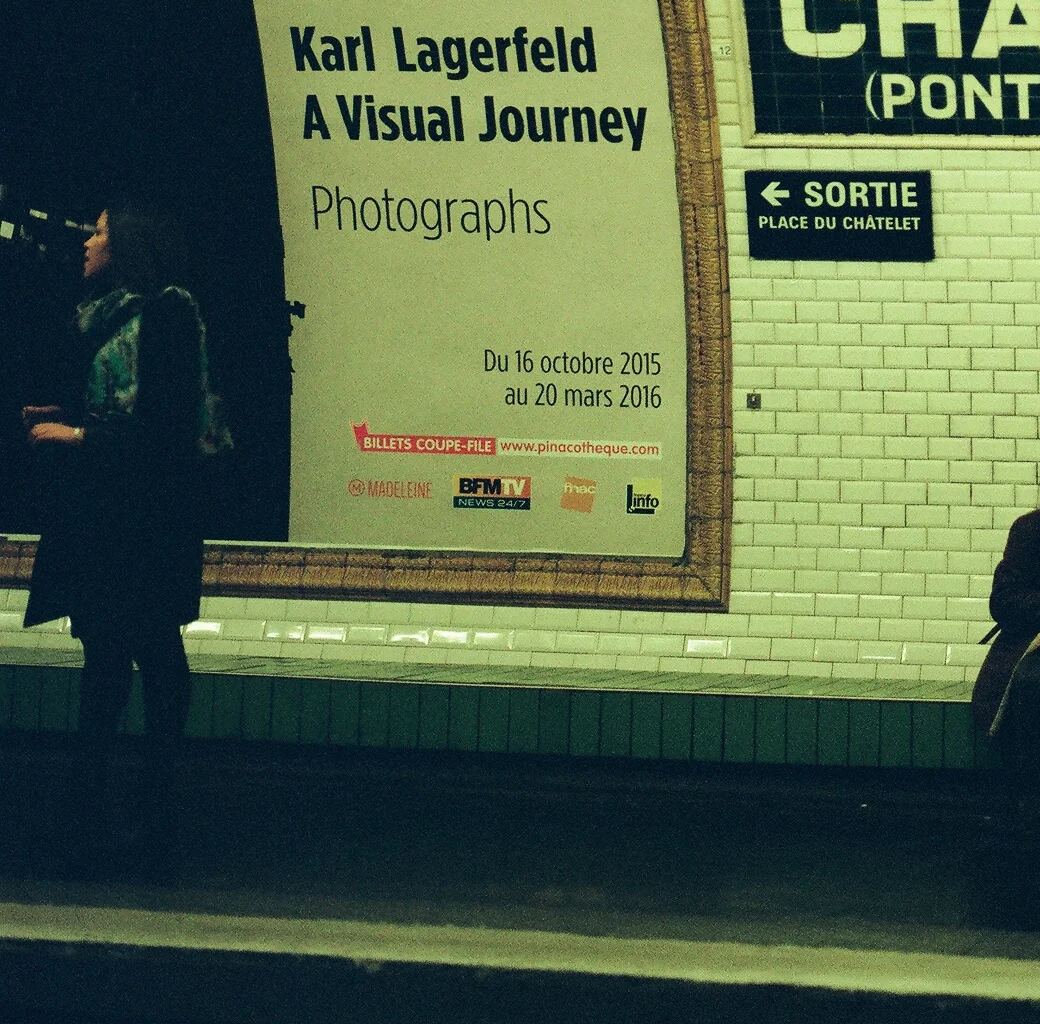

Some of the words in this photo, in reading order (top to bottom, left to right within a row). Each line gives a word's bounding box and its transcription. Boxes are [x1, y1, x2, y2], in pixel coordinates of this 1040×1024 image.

[290, 26, 375, 72] Karl
[393, 26, 597, 80] Lagerfeld
[720, 46, 731, 55] 12
[864, 71, 1040, 122] (PONT
[303, 94, 331, 140] A
[336, 94, 465, 142] Visual
[479, 95, 647, 151] Journey
[804, 181, 918, 207] SORTIE
[312, 186, 551, 241] Photographs
[758, 215, 808, 229] PLACE
[814, 216, 837, 229] DU
[843, 215, 920, 230] CHÂTELET
[484, 349, 508, 372] Du
[515, 350, 534, 373] 16
[540, 352, 613, 375] octobre
[620, 352, 661, 375] 2015
[505, 387, 527, 405] au
[535, 383, 557, 406] 20
[565, 388, 613, 407] mars
[619, 385, 662, 408] 2016
[363, 437, 412, 450] BILLETS
[416, 438, 491, 452] COUPE-FILE
[500, 442, 659, 456] www.pinacotheque.com
[368, 480, 432, 499] MADELEINE
[458, 498, 494, 507] NEWS
[497, 499, 526, 509] 24/7
